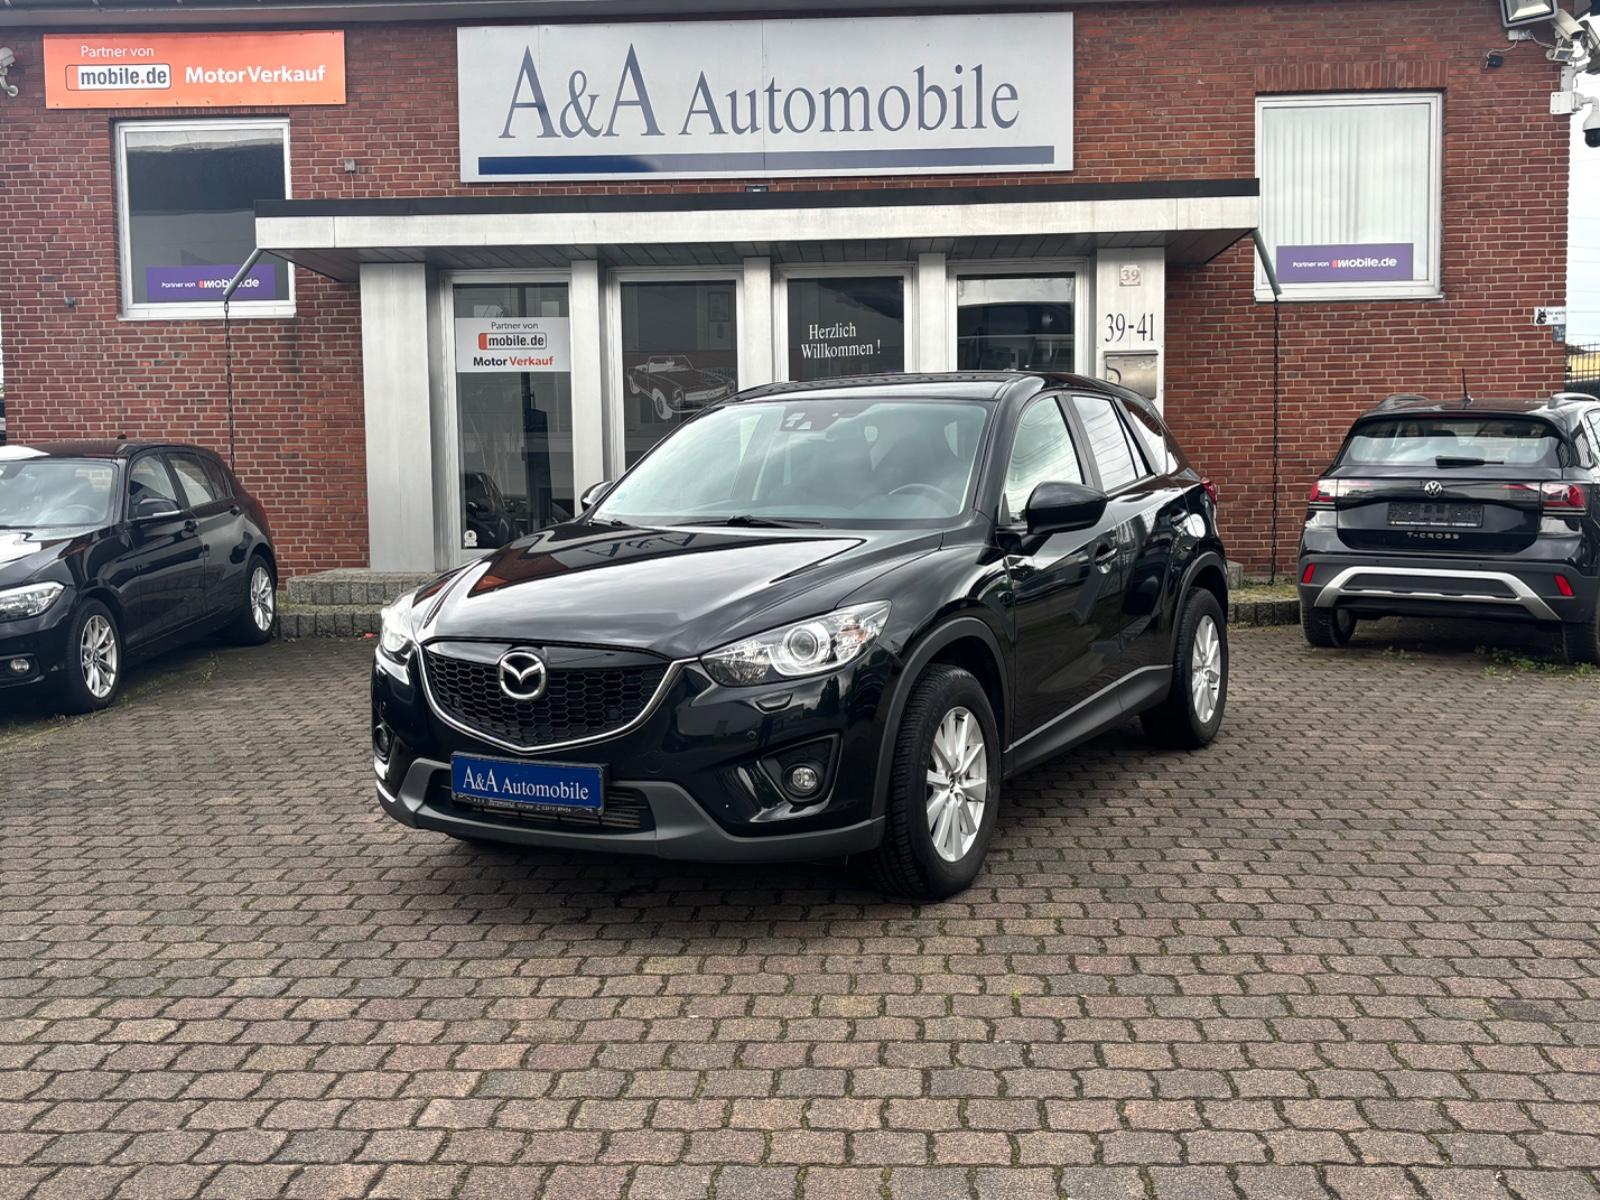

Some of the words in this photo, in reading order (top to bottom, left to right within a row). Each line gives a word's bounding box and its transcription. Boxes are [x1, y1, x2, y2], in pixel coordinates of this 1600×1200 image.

[81, 45, 126, 57] Partner
[130, 47, 154, 57] von
[80, 66, 167, 85] mobile.de
[498, 42, 665, 139] A&A
[679, 63, 1020, 135] Automobile
[1337, 257, 1398, 268] mobile.de
[1121, 269, 1140, 281] 39
[491, 321, 521, 330] Partner
[809, 322, 856, 340] Herzlich
[1104, 312, 1154, 342] 39-41
[488, 334, 544, 346] mobile.de
[1407, 531, 1460, 540] T-CROSS
[463, 765, 499, 793] A&A
[501, 777, 589, 800] Automobile
